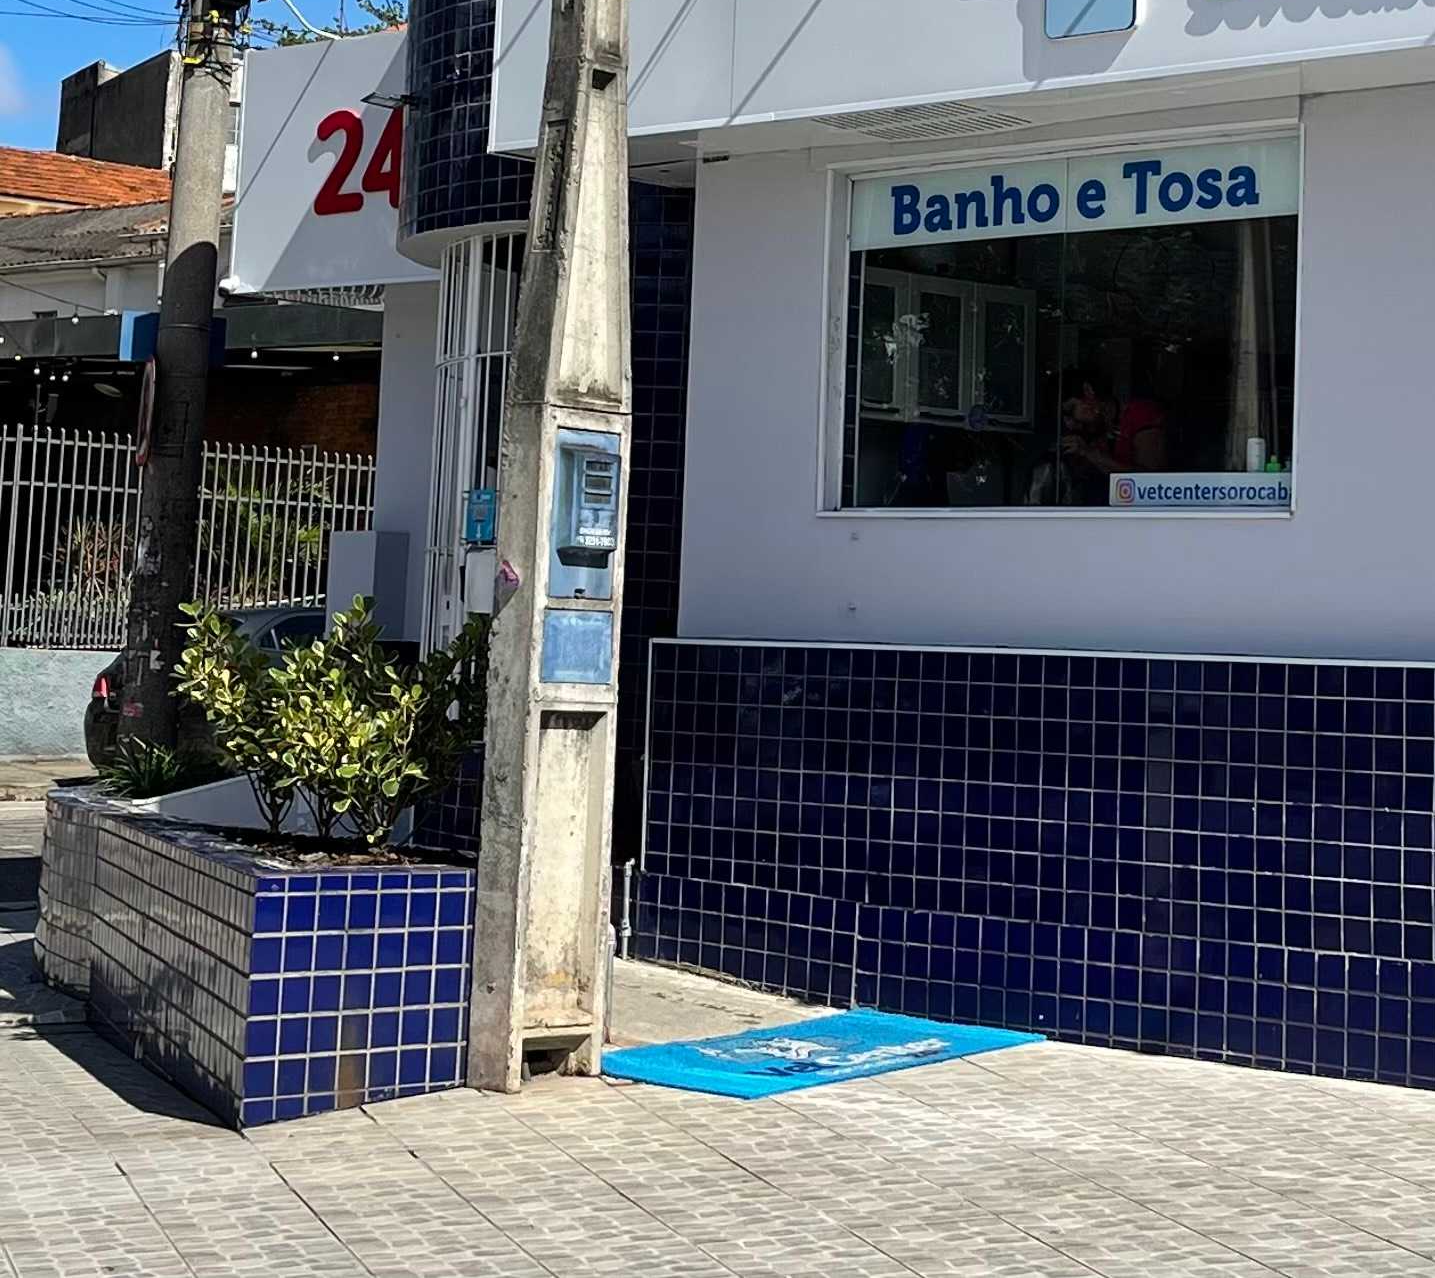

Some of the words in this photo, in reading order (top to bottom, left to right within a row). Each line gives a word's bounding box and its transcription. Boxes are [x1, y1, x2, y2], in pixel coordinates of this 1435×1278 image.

[890, 174, 1061, 236] Banho
[1075, 178, 1107, 220] e
[1121, 159, 1261, 215] Tosa
[1136, 481, 1291, 501] vetcentersorocab
